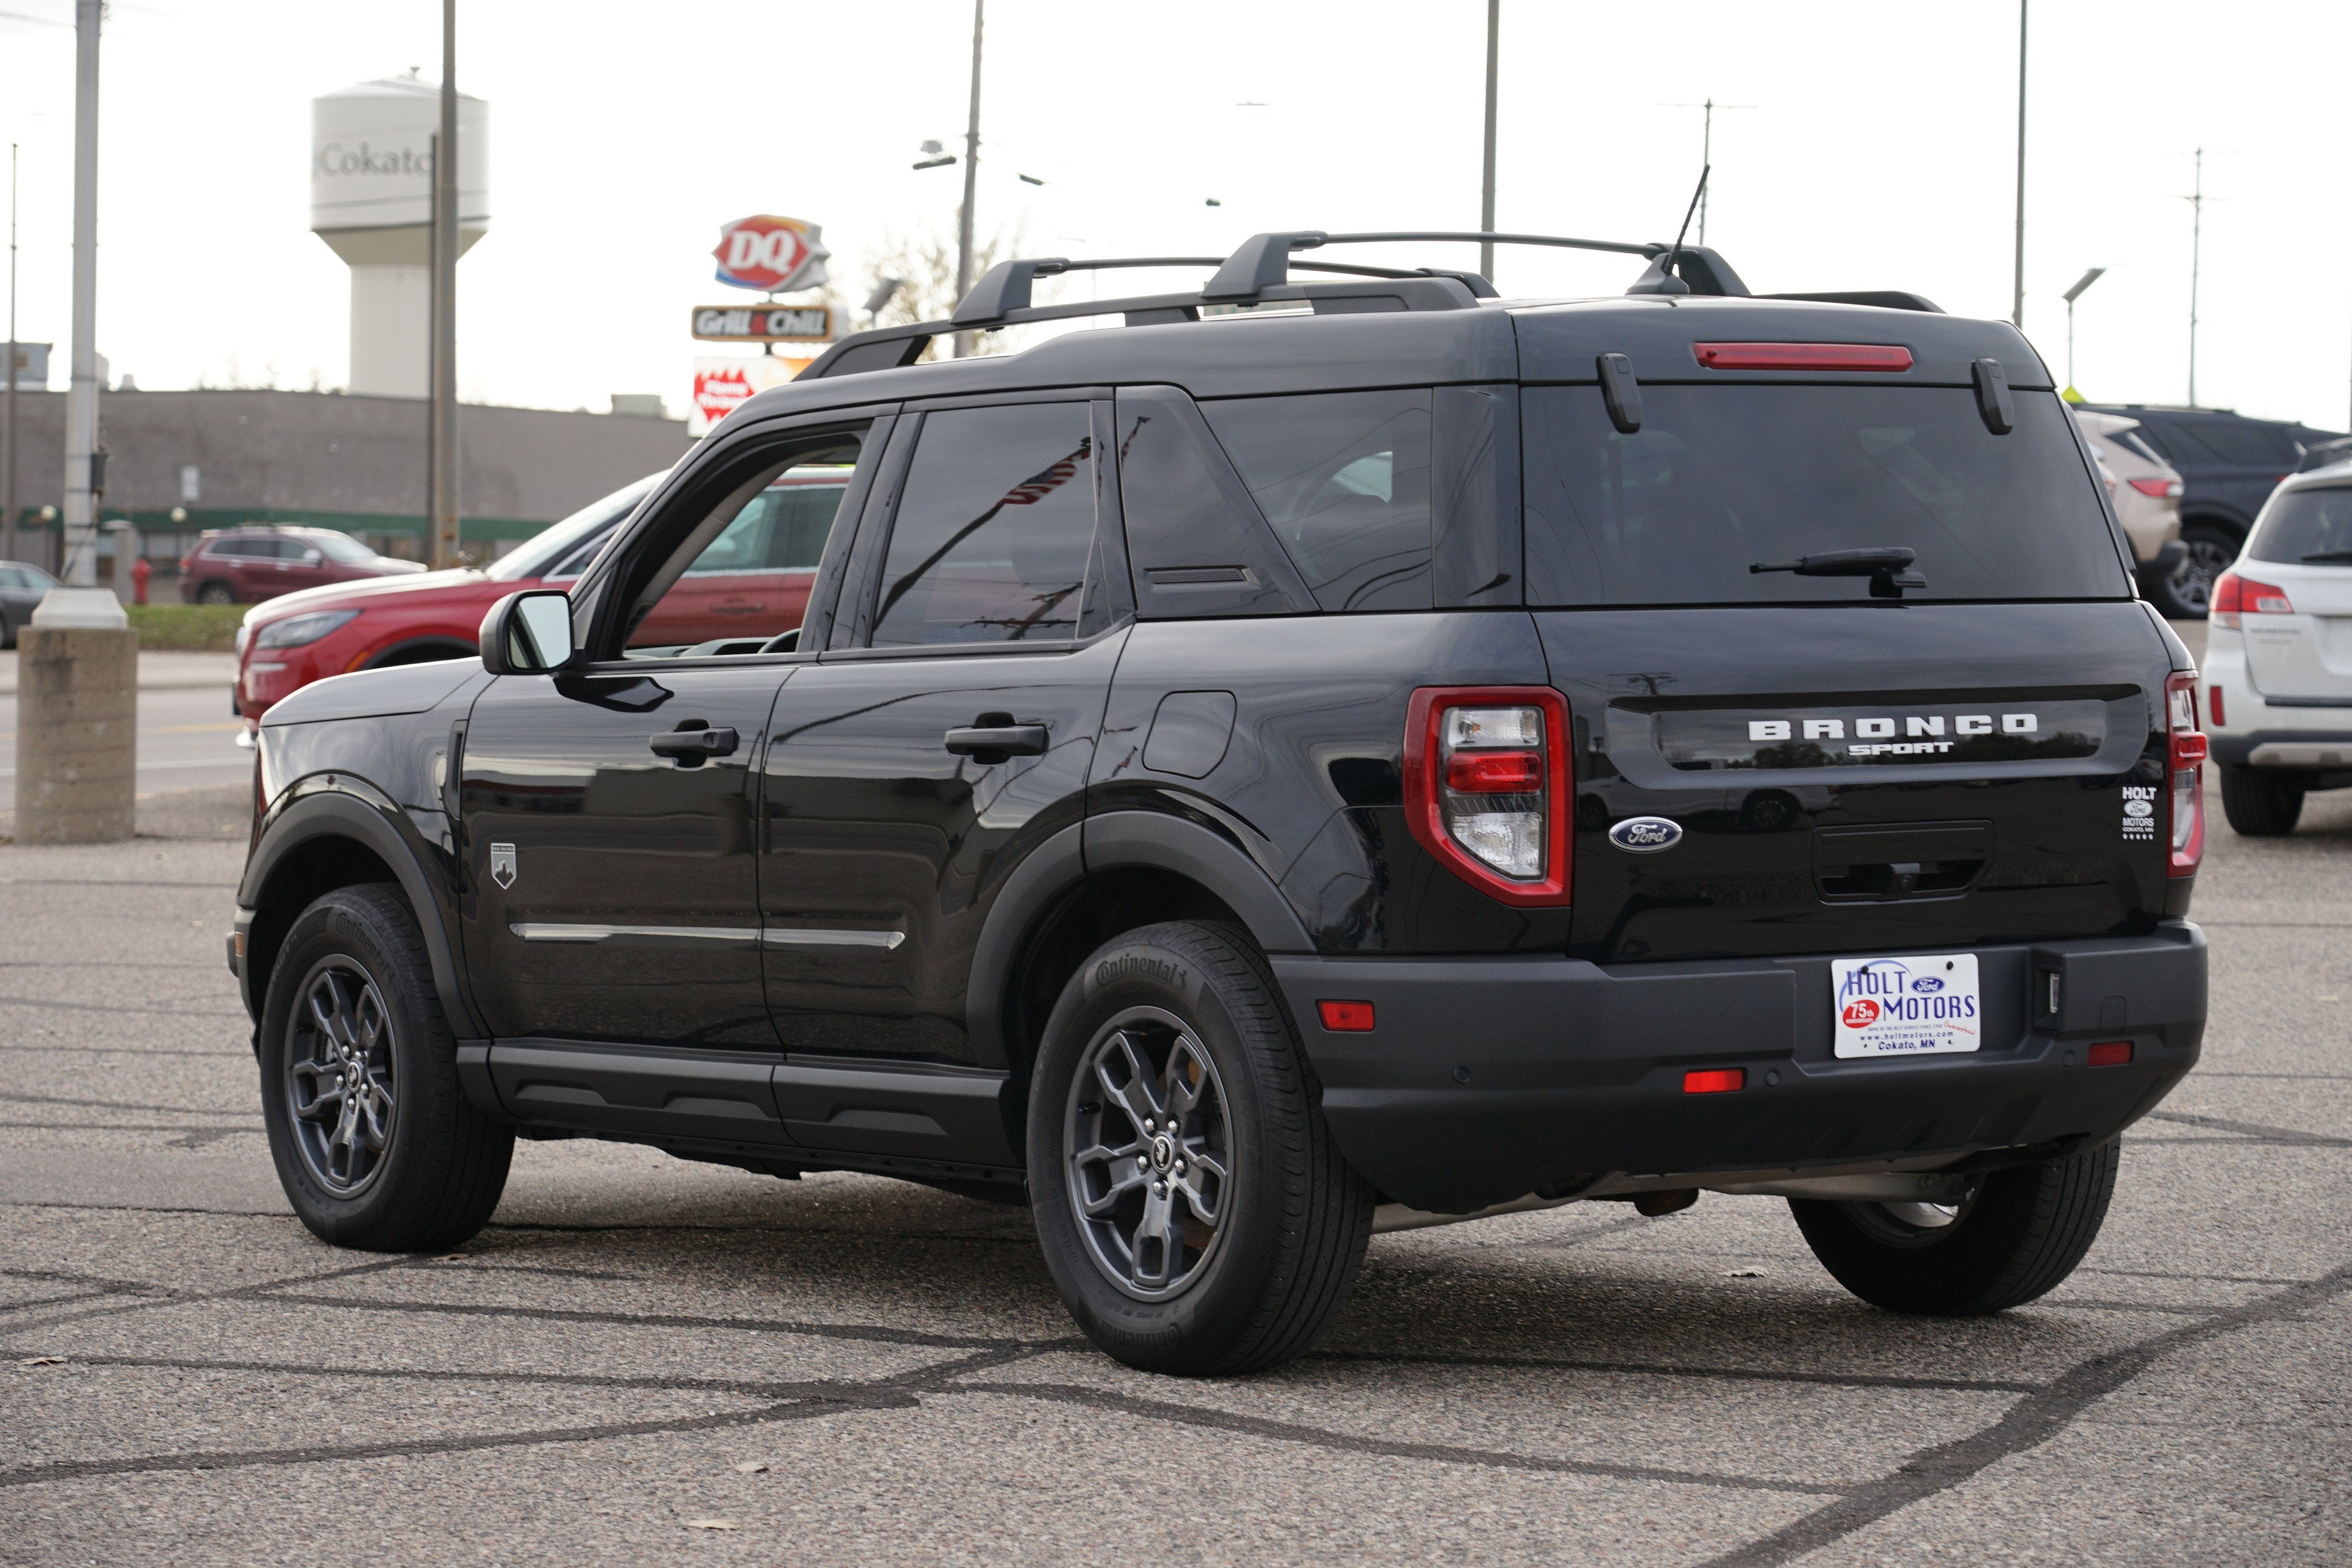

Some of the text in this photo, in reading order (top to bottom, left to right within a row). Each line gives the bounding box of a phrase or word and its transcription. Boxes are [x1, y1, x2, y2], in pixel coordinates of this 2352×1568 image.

[318, 142, 432, 176] Cokato
[726, 229, 796, 274] DQ
[696, 310, 752, 335] Grill
[766, 310, 825, 335] Chill
[1748, 713, 2038, 740] BRONCO
[1848, 742, 1954, 756] SPORT
[2123, 786, 2157, 800] HOLT
[2130, 802, 2148, 813] Ford
[2123, 817, 2154, 826] MOTORS
[1627, 824, 1667, 843] Ford
[1095, 953, 1178, 987] Continental
[1846, 970, 1906, 996] HOLT
[1916, 978, 1941, 993] Ford
[1884, 995, 1975, 1021] MOTORS
[1860, 1031, 1954, 1041] www.holtmotors.com
[1878, 1040, 1936, 1051] Cokato, MN
